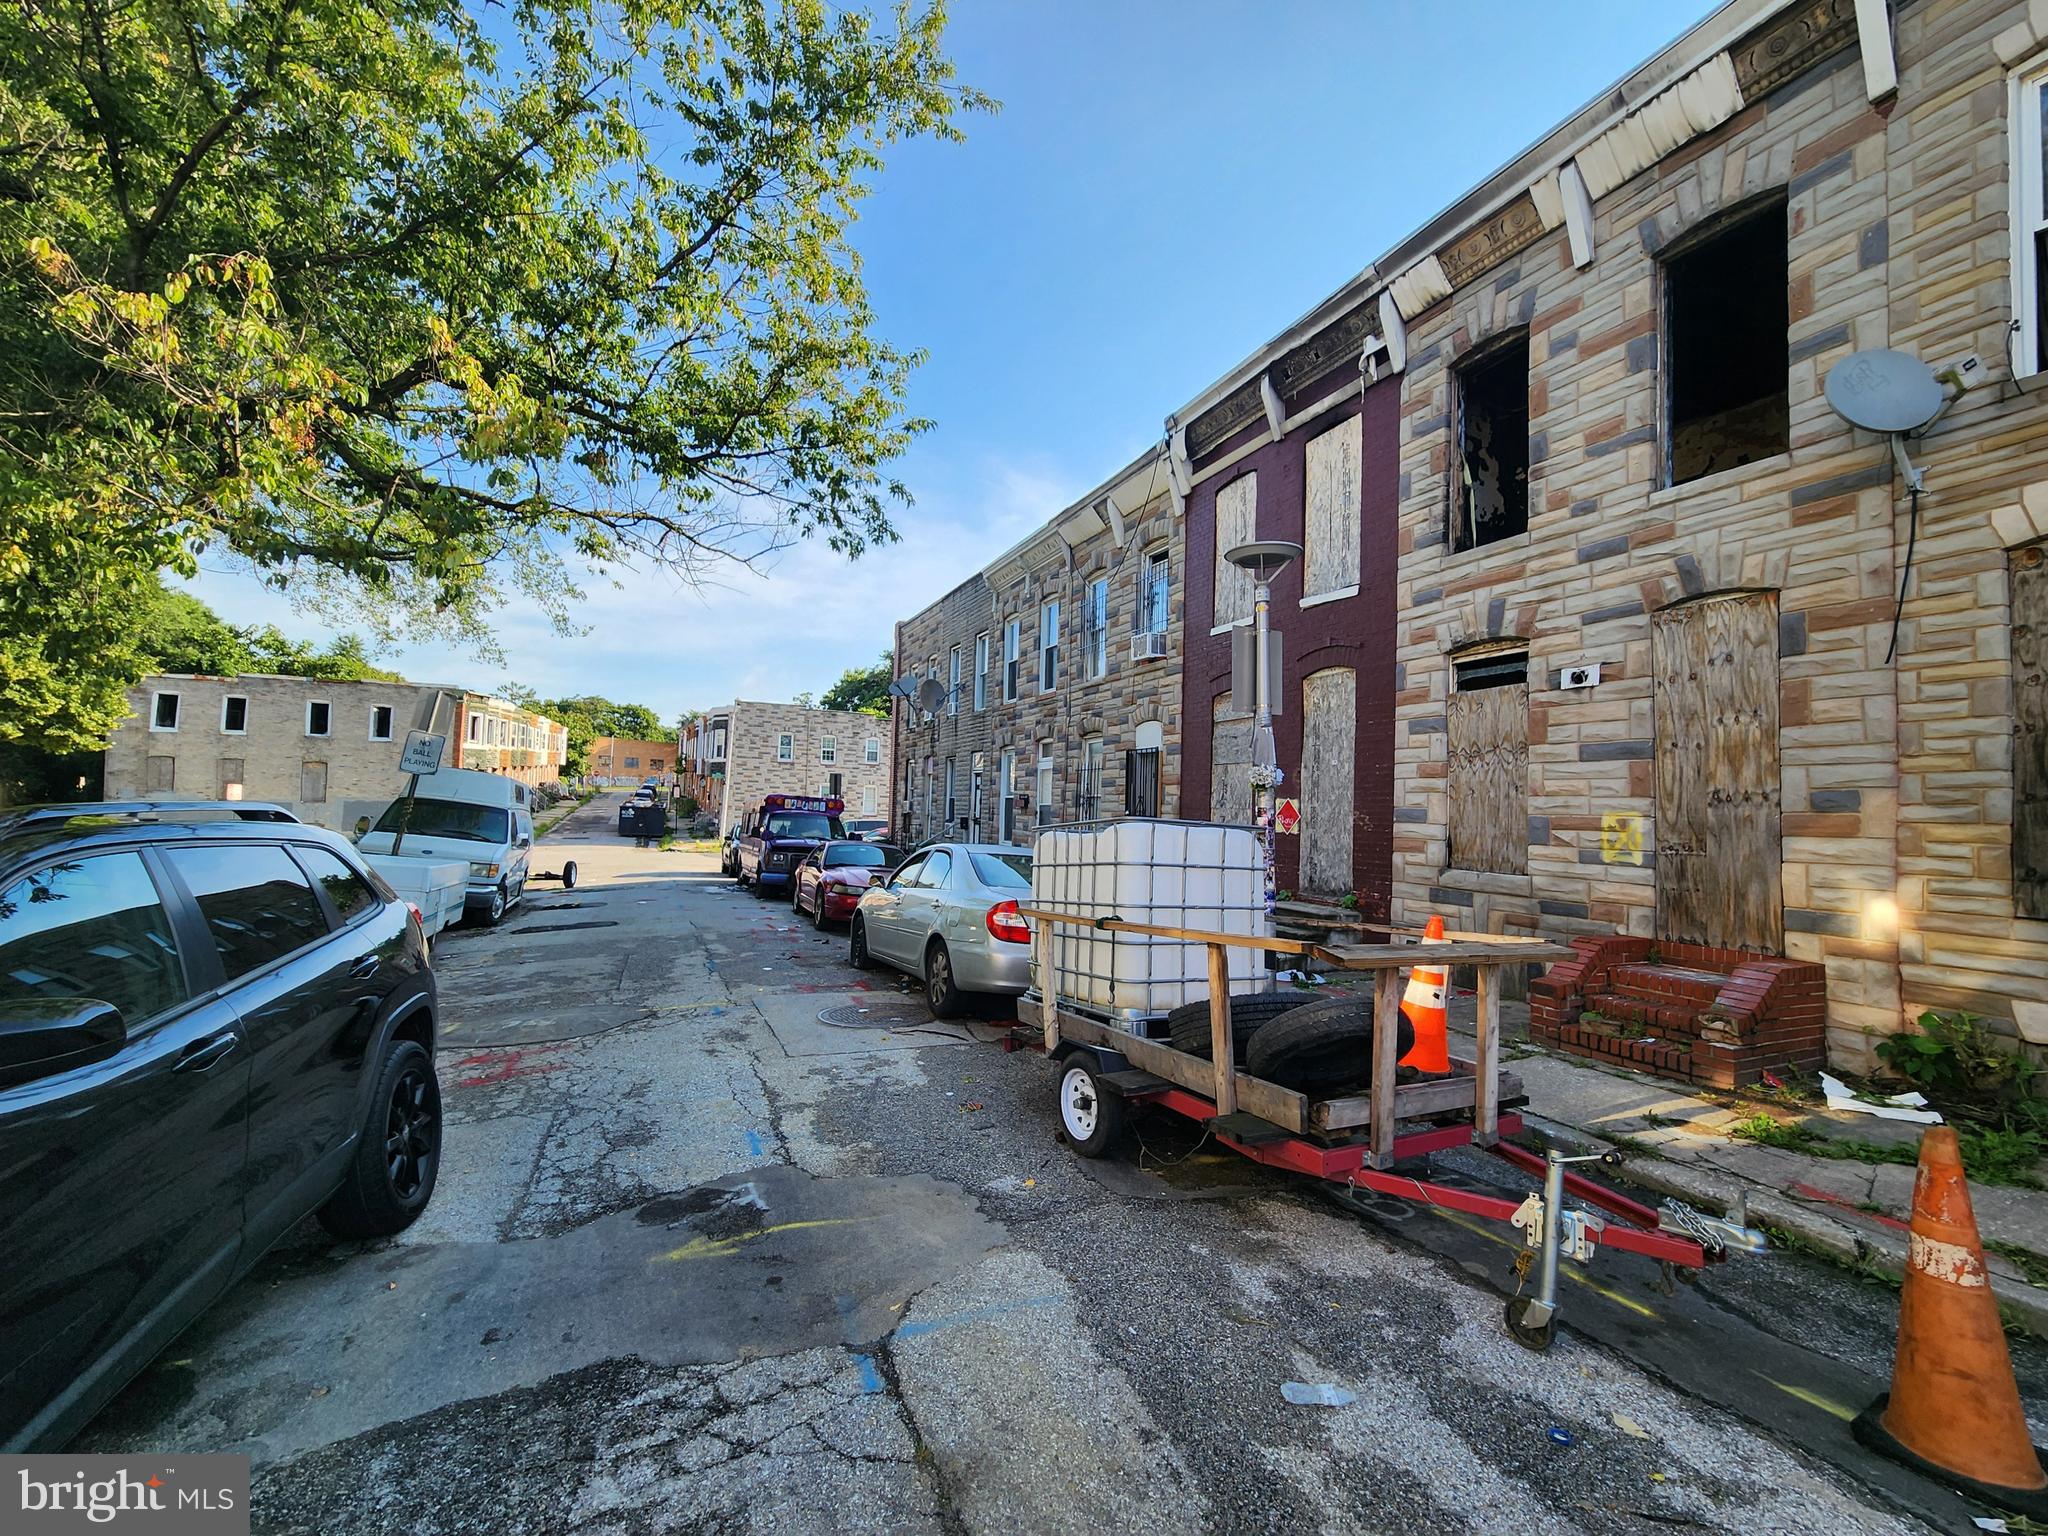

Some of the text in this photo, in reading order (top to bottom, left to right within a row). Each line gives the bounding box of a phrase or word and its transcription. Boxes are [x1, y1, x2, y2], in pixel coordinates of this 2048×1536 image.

[419, 739, 431, 747] NO
[412, 748, 432, 757] BALL
[404, 757, 436, 769] PLAYING
